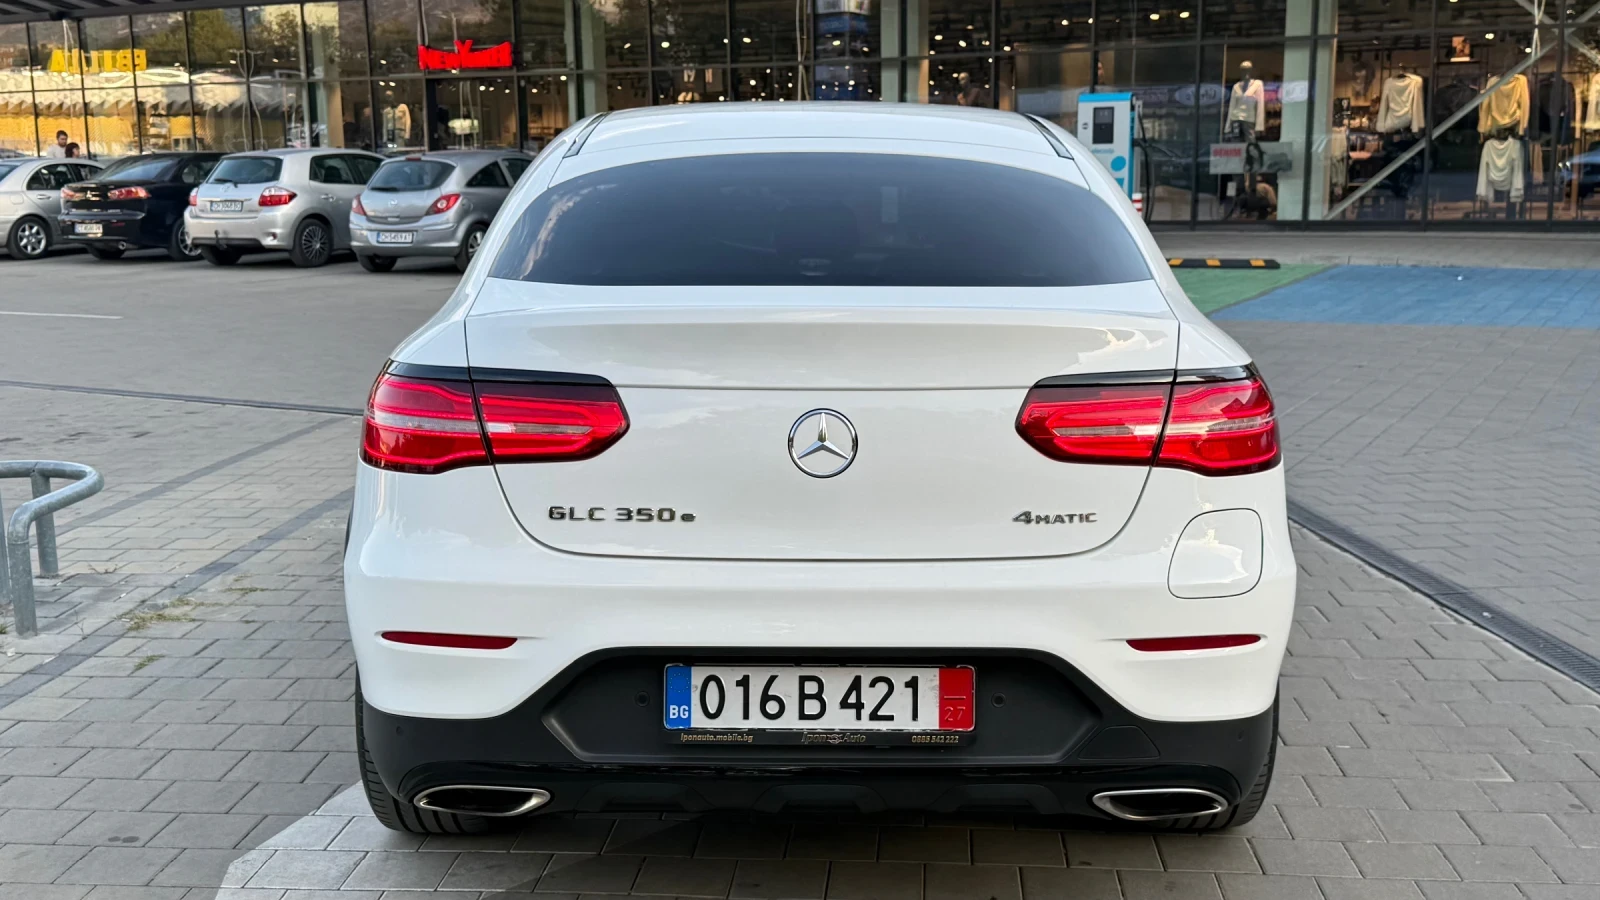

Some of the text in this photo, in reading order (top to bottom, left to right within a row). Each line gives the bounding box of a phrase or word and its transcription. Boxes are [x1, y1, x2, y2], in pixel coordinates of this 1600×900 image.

[548, 506, 697, 522] GLC 350 e
[1012, 510, 1098, 525] 4MATIC
[669, 705, 690, 719] BG
[944, 706, 967, 722] 27
[842, 732, 867, 743] Auto
